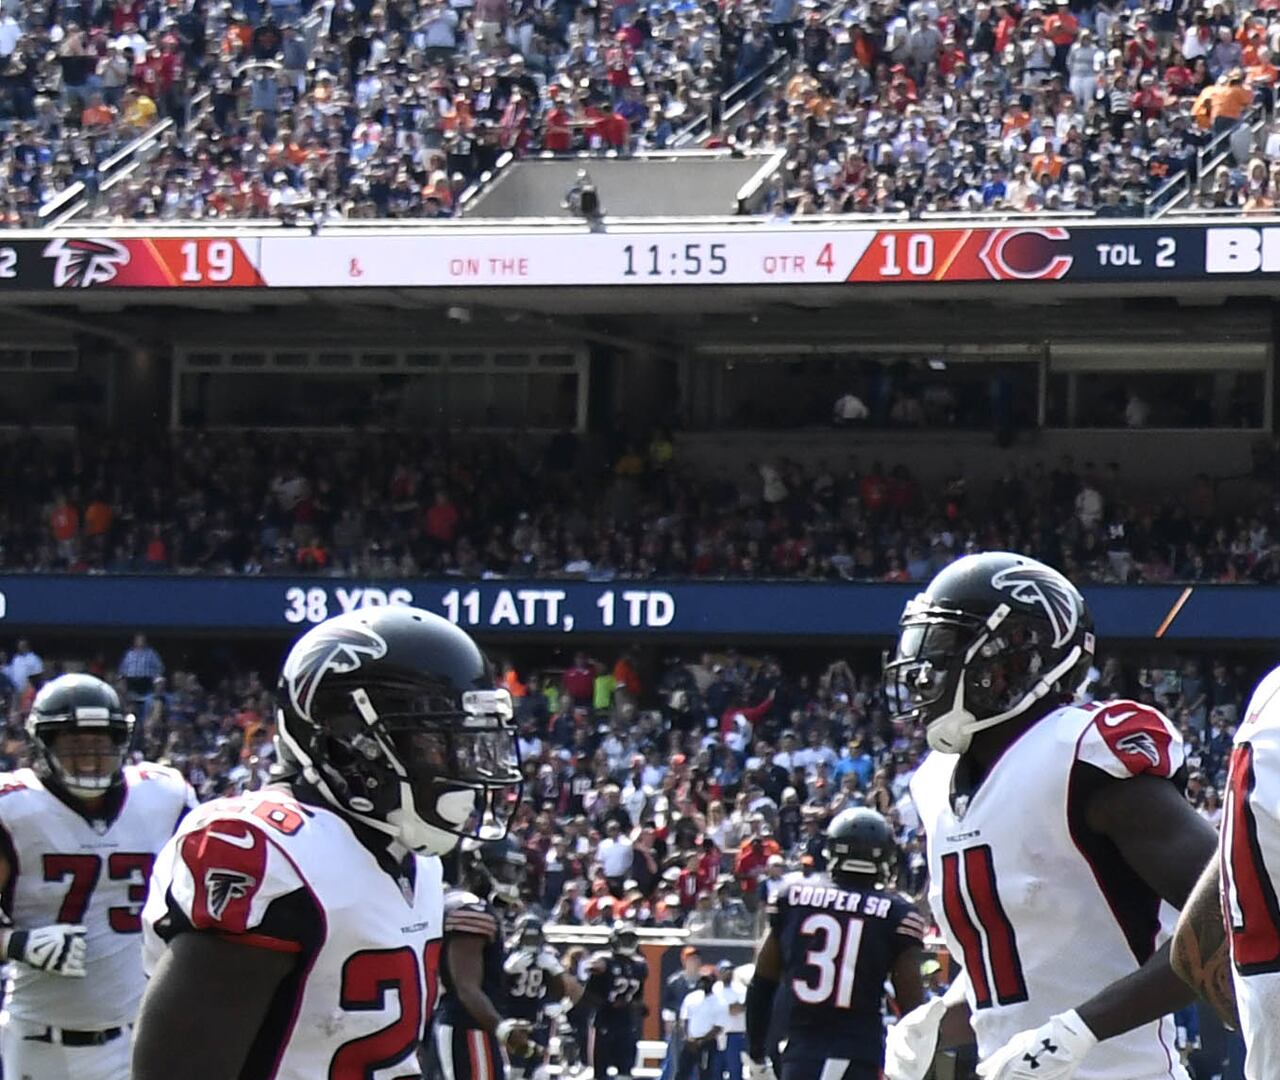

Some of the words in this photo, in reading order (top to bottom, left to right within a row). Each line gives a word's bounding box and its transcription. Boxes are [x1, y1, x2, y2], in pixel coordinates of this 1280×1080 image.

[0, 248, 17, 278] 2
[181, 242, 233, 281] 19
[450, 258, 479, 276] ON
[489, 258, 528, 275] THE
[622, 244, 727, 276] 11:55
[763, 255, 805, 274] QTR
[816, 243, 834, 274] 4
[879, 234, 934, 276] 10
[1096, 244, 1141, 266] TOL
[1155, 237, 1176, 267] 2
[285, 589, 328, 623] 38
[442, 589, 480, 625] 11
[489, 590, 574, 631] ATT,
[597, 592, 615, 625] 1
[623, 593, 676, 627] TD
[43, 852, 152, 933] 73
[788, 884, 862, 912] COOPER
[863, 895, 892, 919] SR
[940, 844, 1029, 1009] 11
[792, 913, 864, 1008] 31
